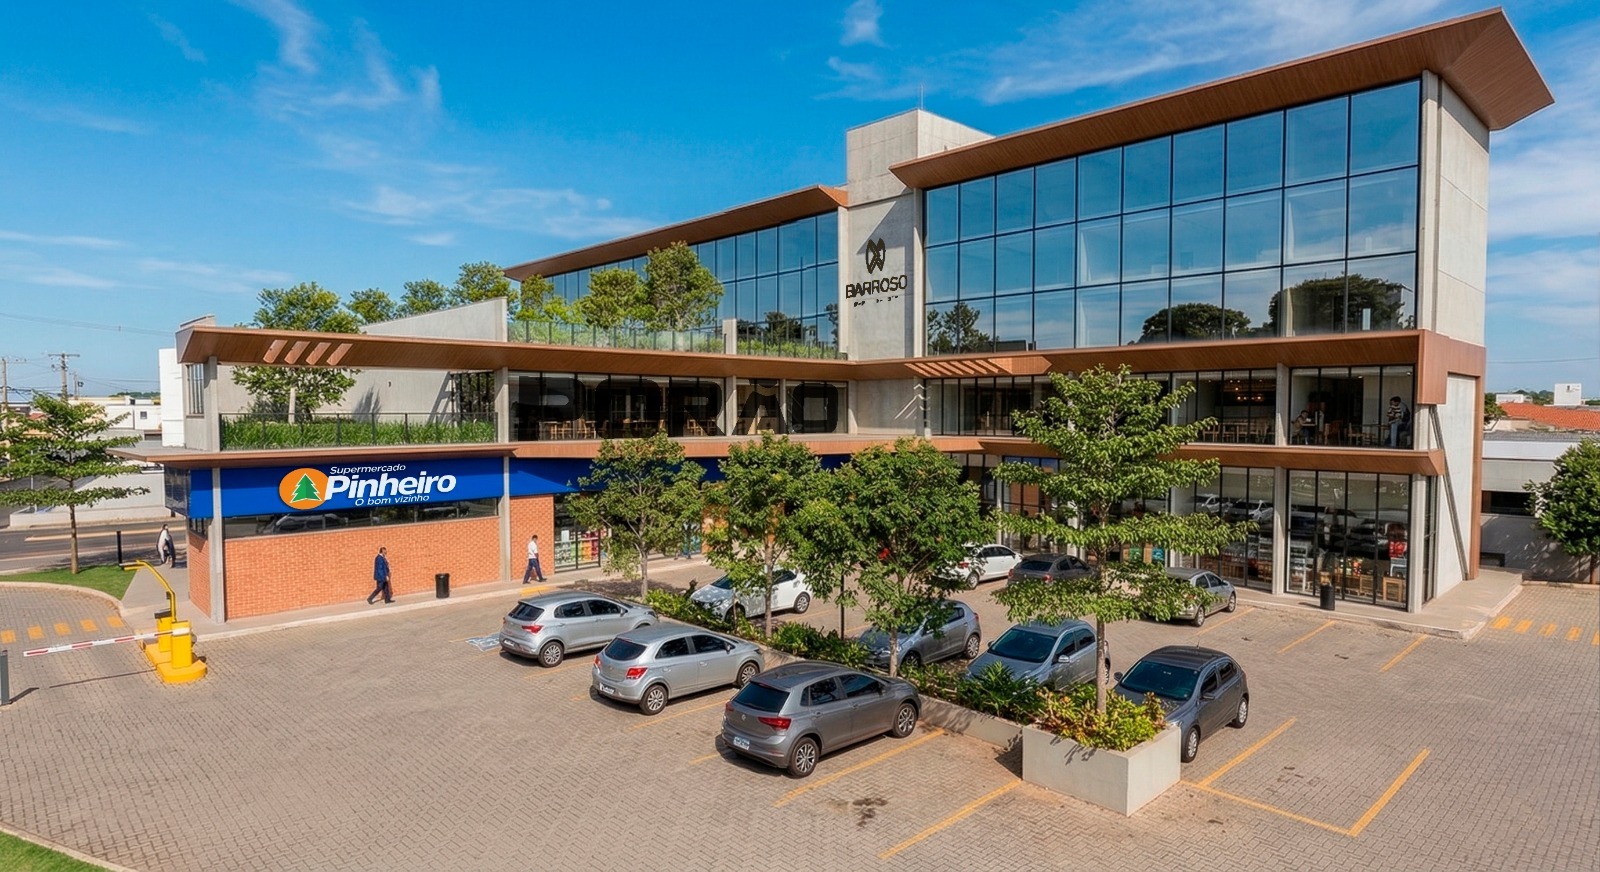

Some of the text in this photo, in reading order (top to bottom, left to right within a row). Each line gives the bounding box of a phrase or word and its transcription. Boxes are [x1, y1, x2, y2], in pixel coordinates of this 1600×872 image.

[846, 275, 907, 299] BARROSO
[330, 463, 406, 475] Supermercado
[324, 471, 457, 500] Pinheiro
[354, 494, 430, 507] O bom vizinho
